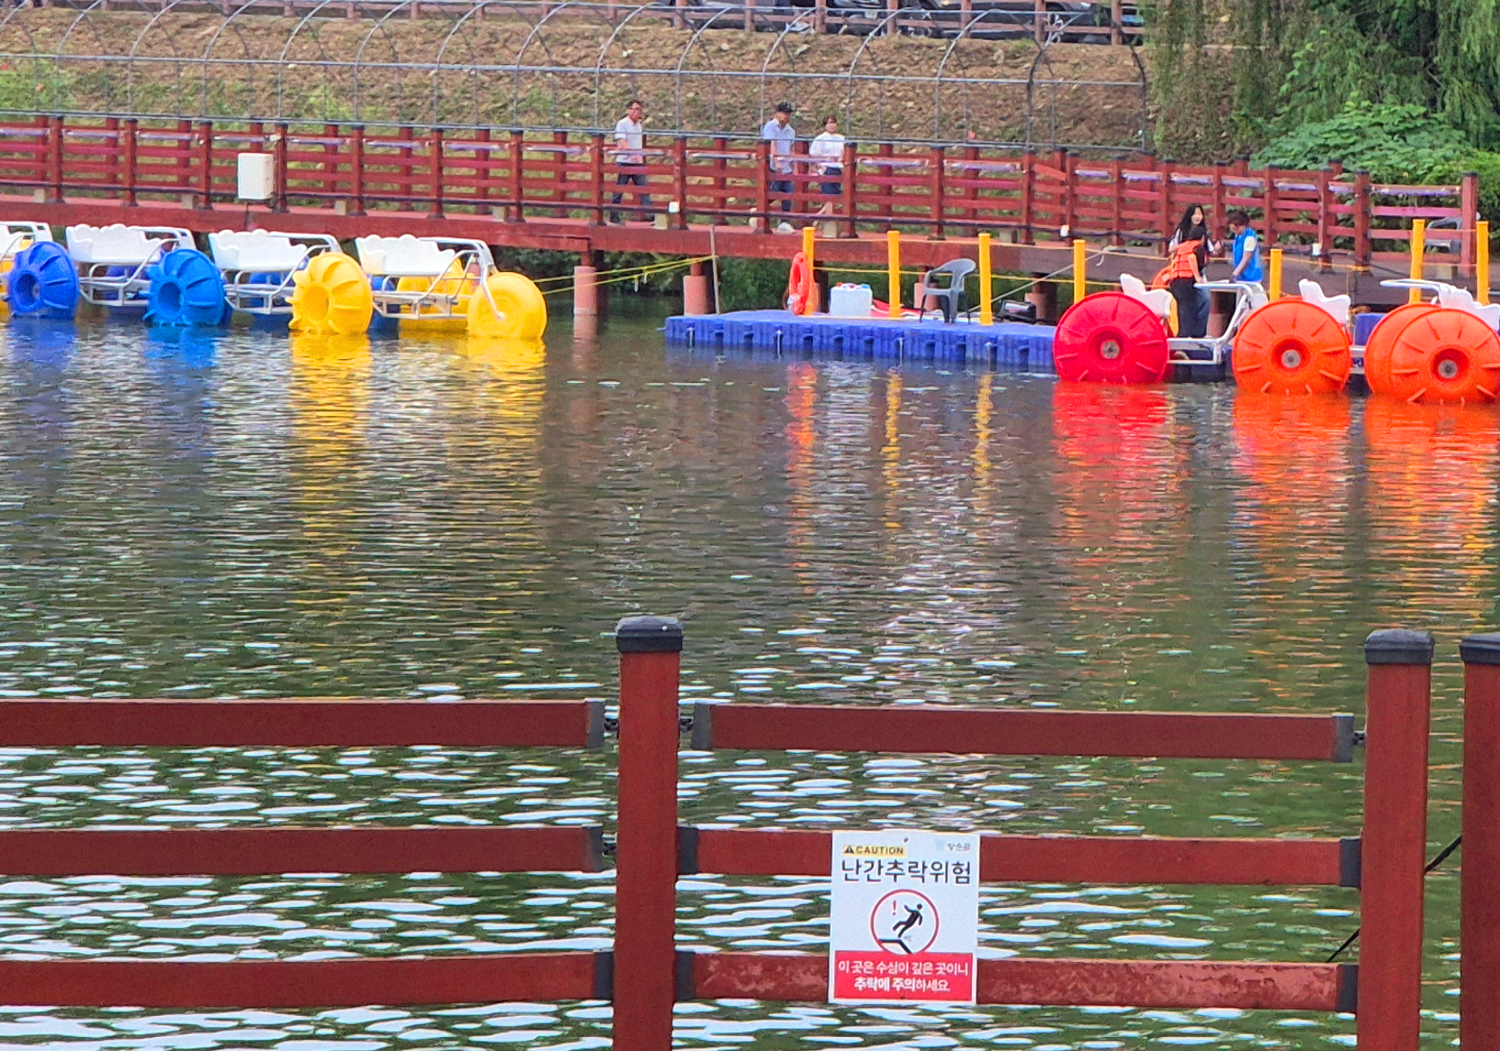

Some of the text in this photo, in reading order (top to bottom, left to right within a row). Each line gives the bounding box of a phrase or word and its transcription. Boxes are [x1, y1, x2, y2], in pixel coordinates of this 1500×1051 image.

[856, 845, 904, 855] CAUTION
[841, 859, 970, 884] 난간추락위험
[838, 960, 969, 976] 이 곳은 수심이 깊은 곳이니
[854, 977, 890, 992] 추락에
